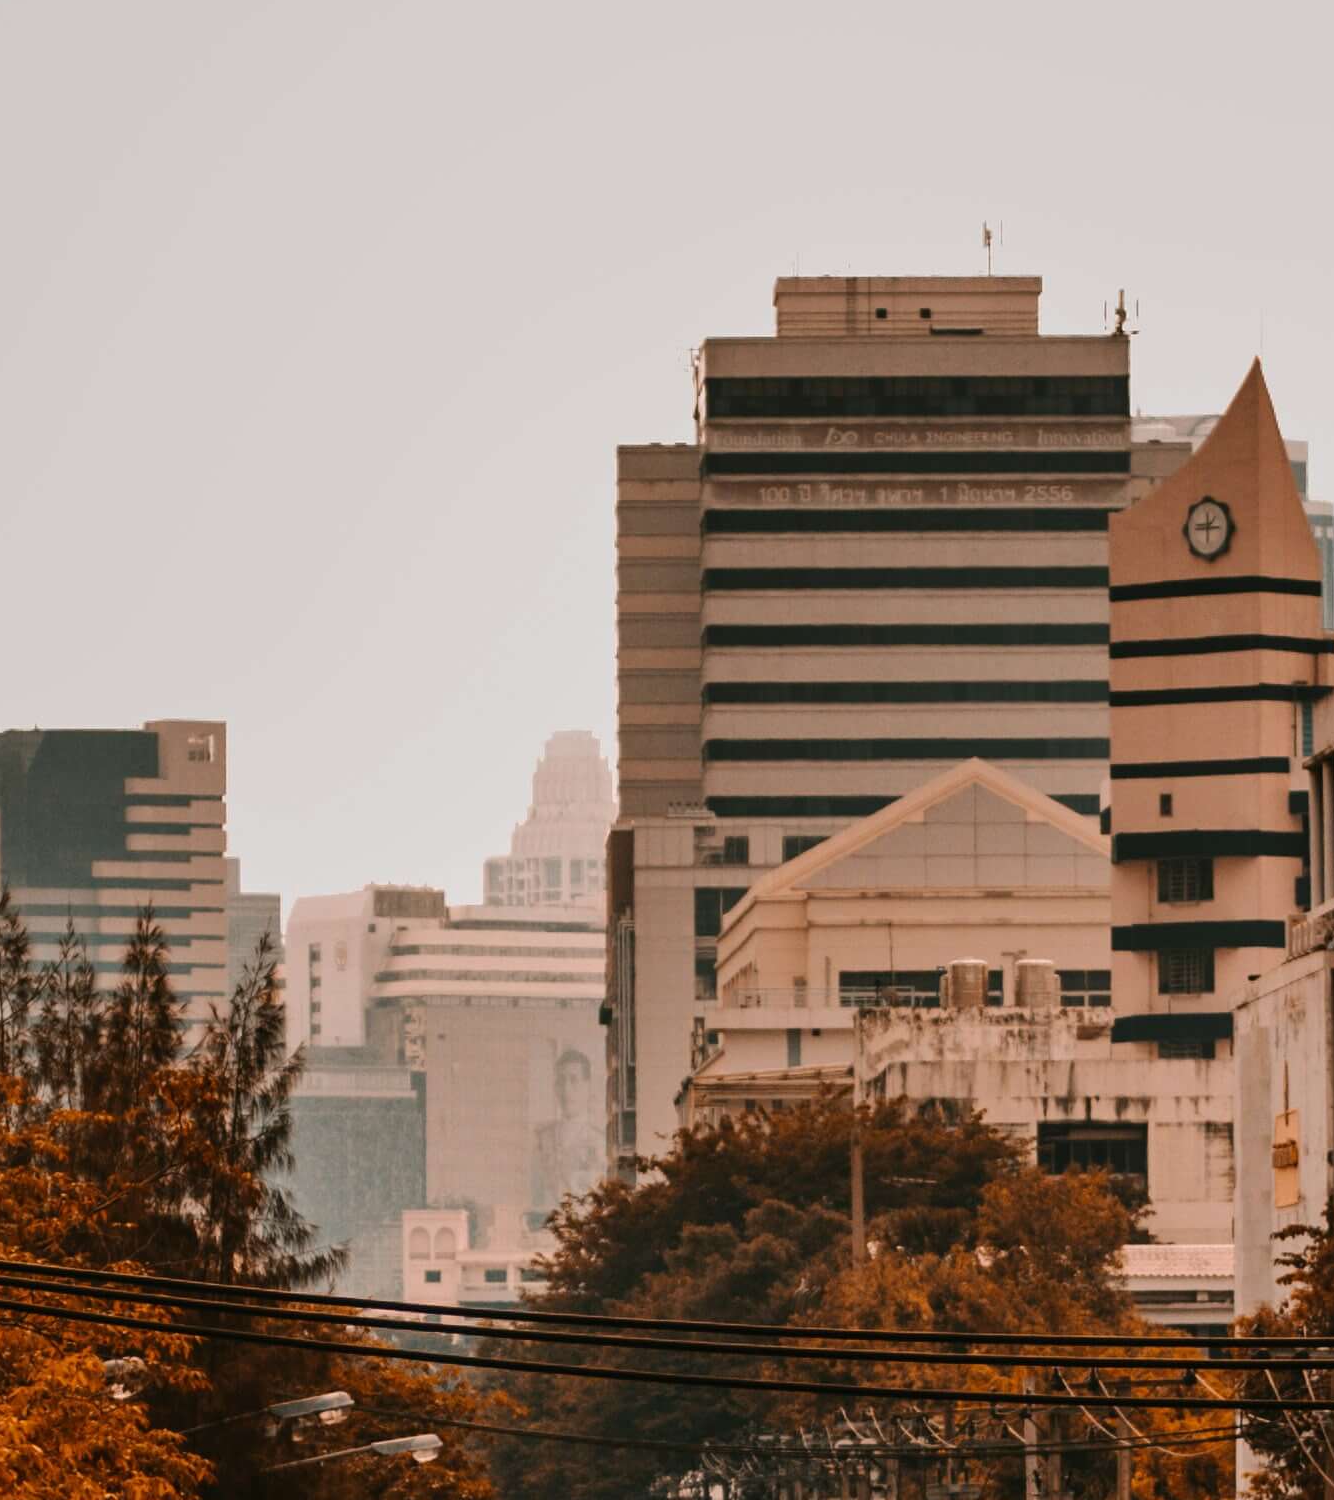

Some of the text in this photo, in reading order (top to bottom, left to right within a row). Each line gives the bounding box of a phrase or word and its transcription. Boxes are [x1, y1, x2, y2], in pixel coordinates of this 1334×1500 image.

[714, 430, 802, 445] Foundation
[874, 431, 1014, 444] CHULA ENGINEERING
[1037, 429, 1123, 445] Innovation
[759, 487, 790, 501] 100
[1024, 485, 1074, 501] 2556
